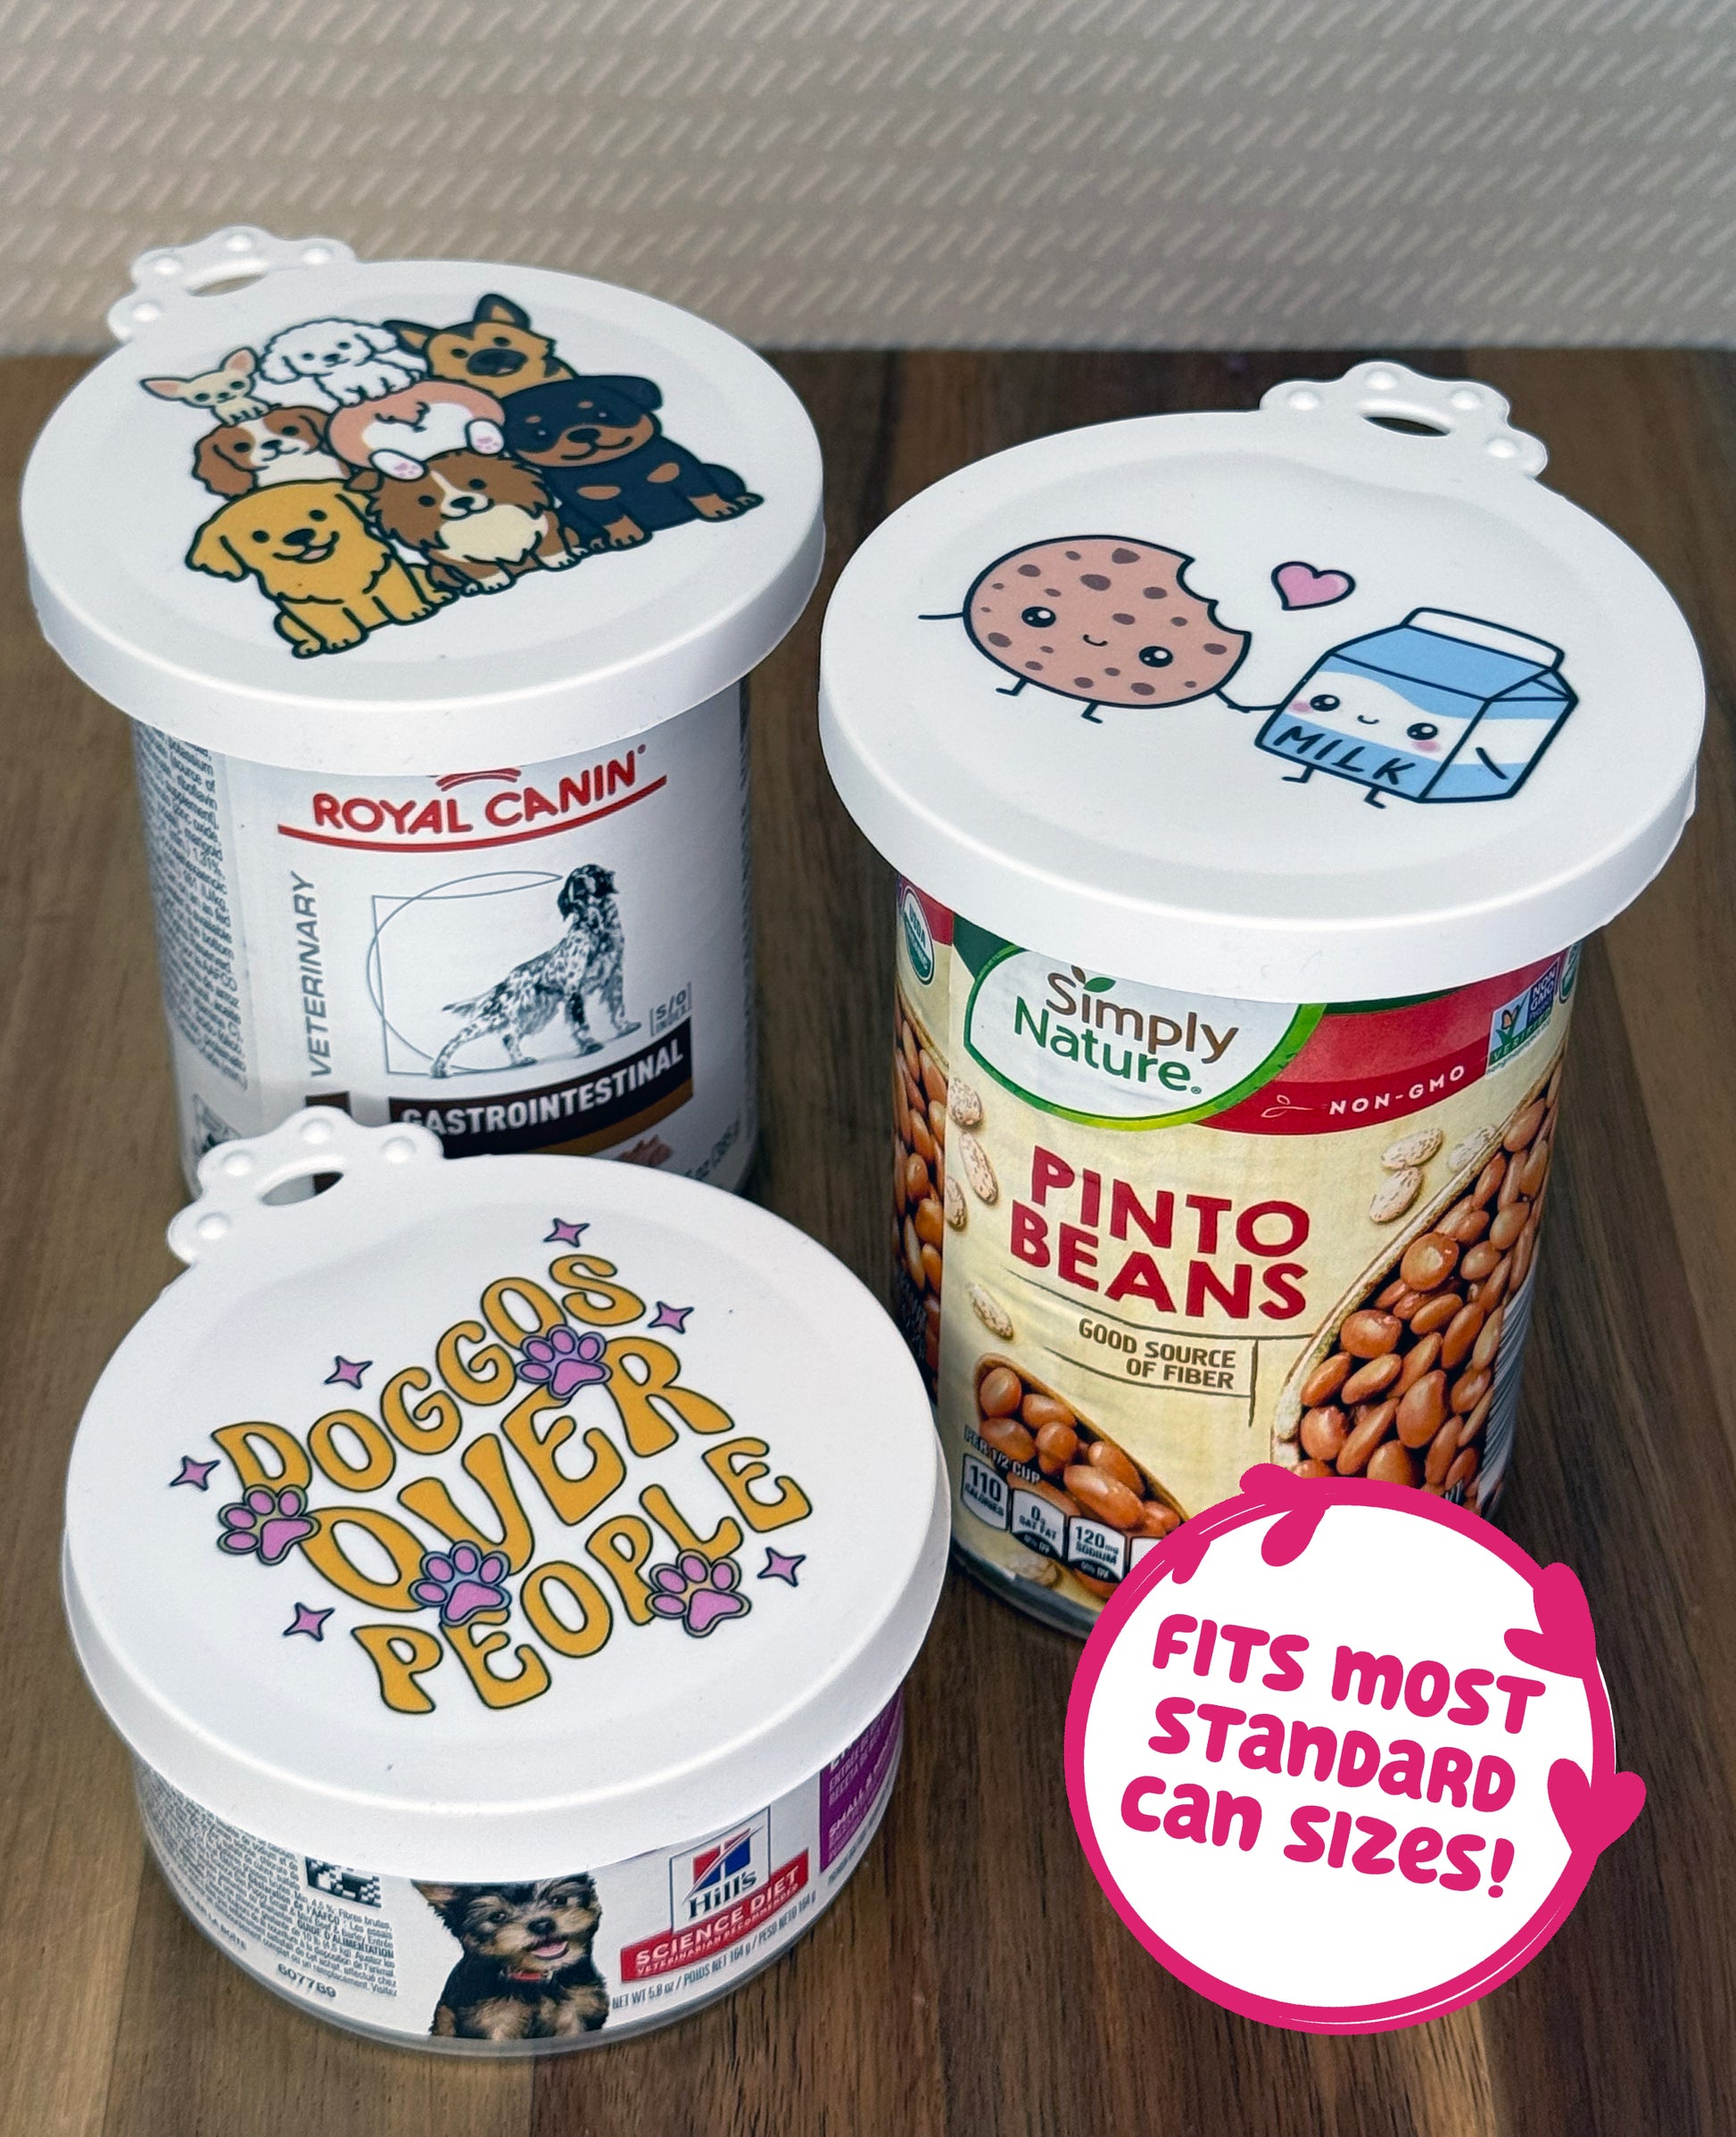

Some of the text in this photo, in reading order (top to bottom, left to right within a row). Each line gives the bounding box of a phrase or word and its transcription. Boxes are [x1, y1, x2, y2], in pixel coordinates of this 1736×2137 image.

[313, 750, 637, 834] ROYAL CANIN
[1272, 725, 1417, 785] MILK
[290, 870, 333, 1077] VETERINARY
[1531, 980, 1554, 1011] GMO
[1533, 968, 1556, 998] NON
[1046, 969, 1239, 1065] Simply
[401, 1038, 685, 1136] GASTROINTESTINAL
[1329, 1064, 1465, 1115] NON-GMO
[1031, 1145, 1310, 1258] PINTO
[1011, 1199, 1309, 1320] BEANS
[211, 1254, 646, 1492] DOGGOS
[1079, 1317, 1236, 1370] GOOD SOURCE
[1126, 1358, 1235, 1389] OF FIBER
[299, 1336, 735, 1613] OVER
[970, 1464, 1001, 1502] 110
[1013, 1462, 1041, 1484] CUP
[351, 1436, 813, 1714] PEOPLE
[635, 1865, 799, 1964] SCIENCE DIET
[635, 1883, 799, 1976] VETERINARIAN RECOMMENDED
[689, 1871, 757, 1918] Hill's
[612, 1992, 630, 2009] NET
[632, 1988, 647, 2004] WT
[649, 1984, 663, 2000] 5.8
[664, 1981, 674, 1994] oz
[683, 1964, 711, 1986] POIDS
[712, 1956, 728, 1973] NET
[730, 1948, 744, 1962] 164
[758, 1925, 777, 1946] PESO
